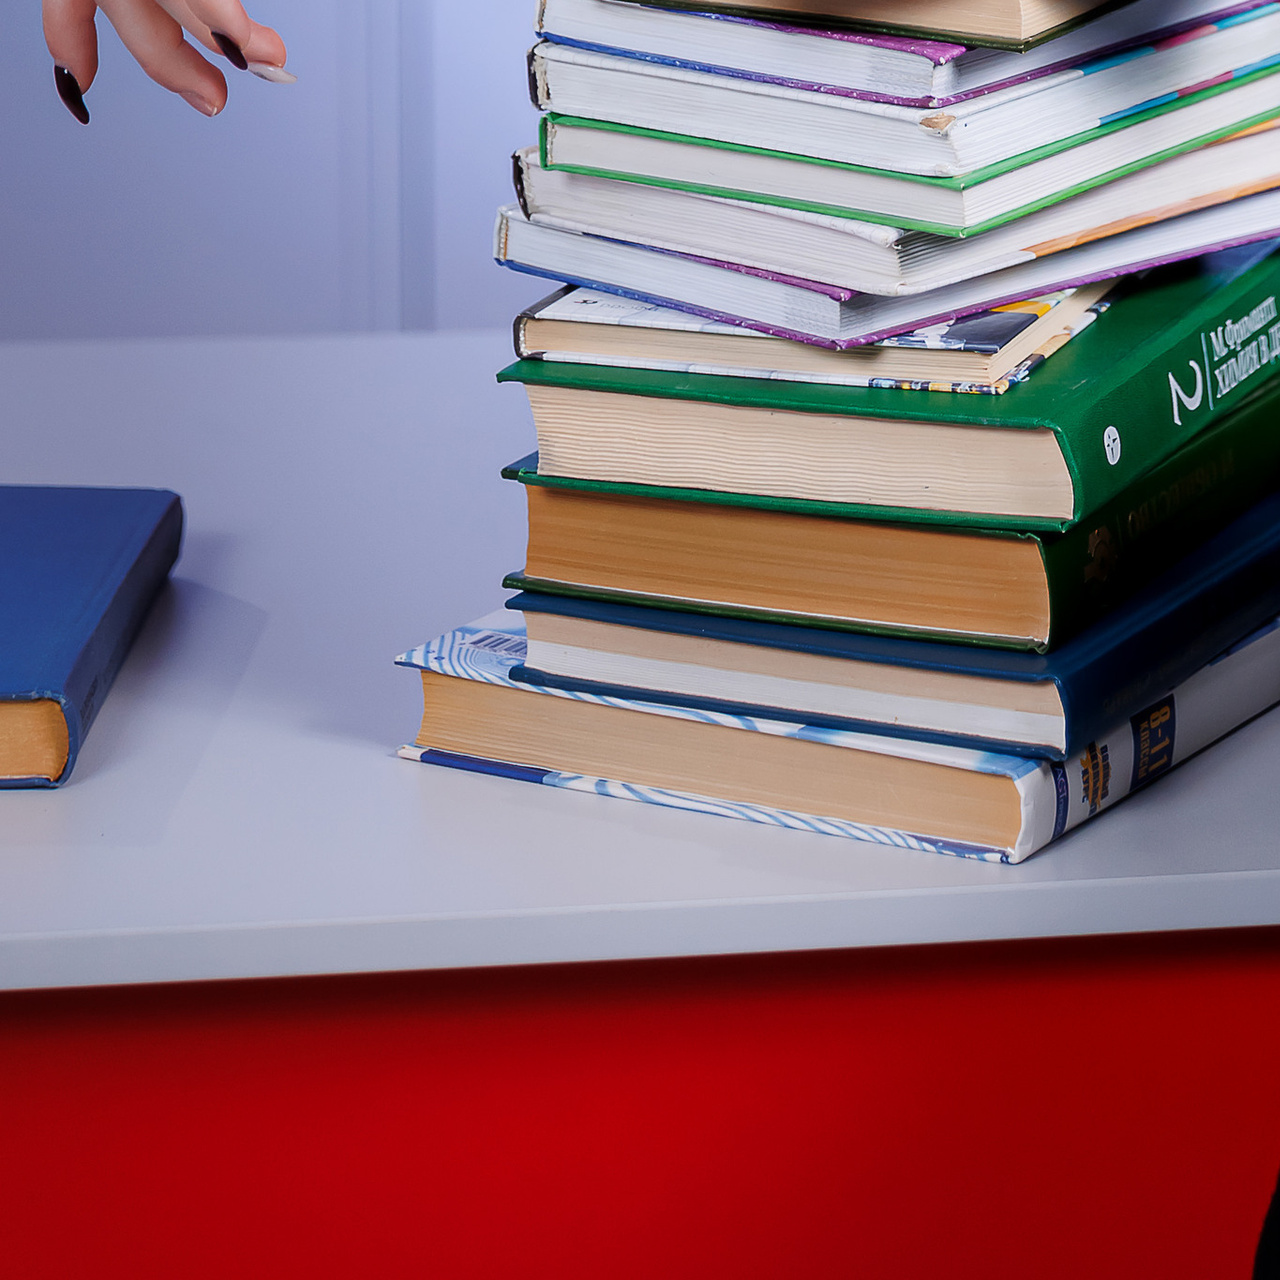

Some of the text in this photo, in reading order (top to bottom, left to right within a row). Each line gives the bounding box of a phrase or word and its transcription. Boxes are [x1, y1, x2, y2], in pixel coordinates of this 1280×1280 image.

[1214, 340, 1260, 398] ХИМИЯ
[1258, 335, 1270, 366] В
[1149, 705, 1171, 772] 8-11
